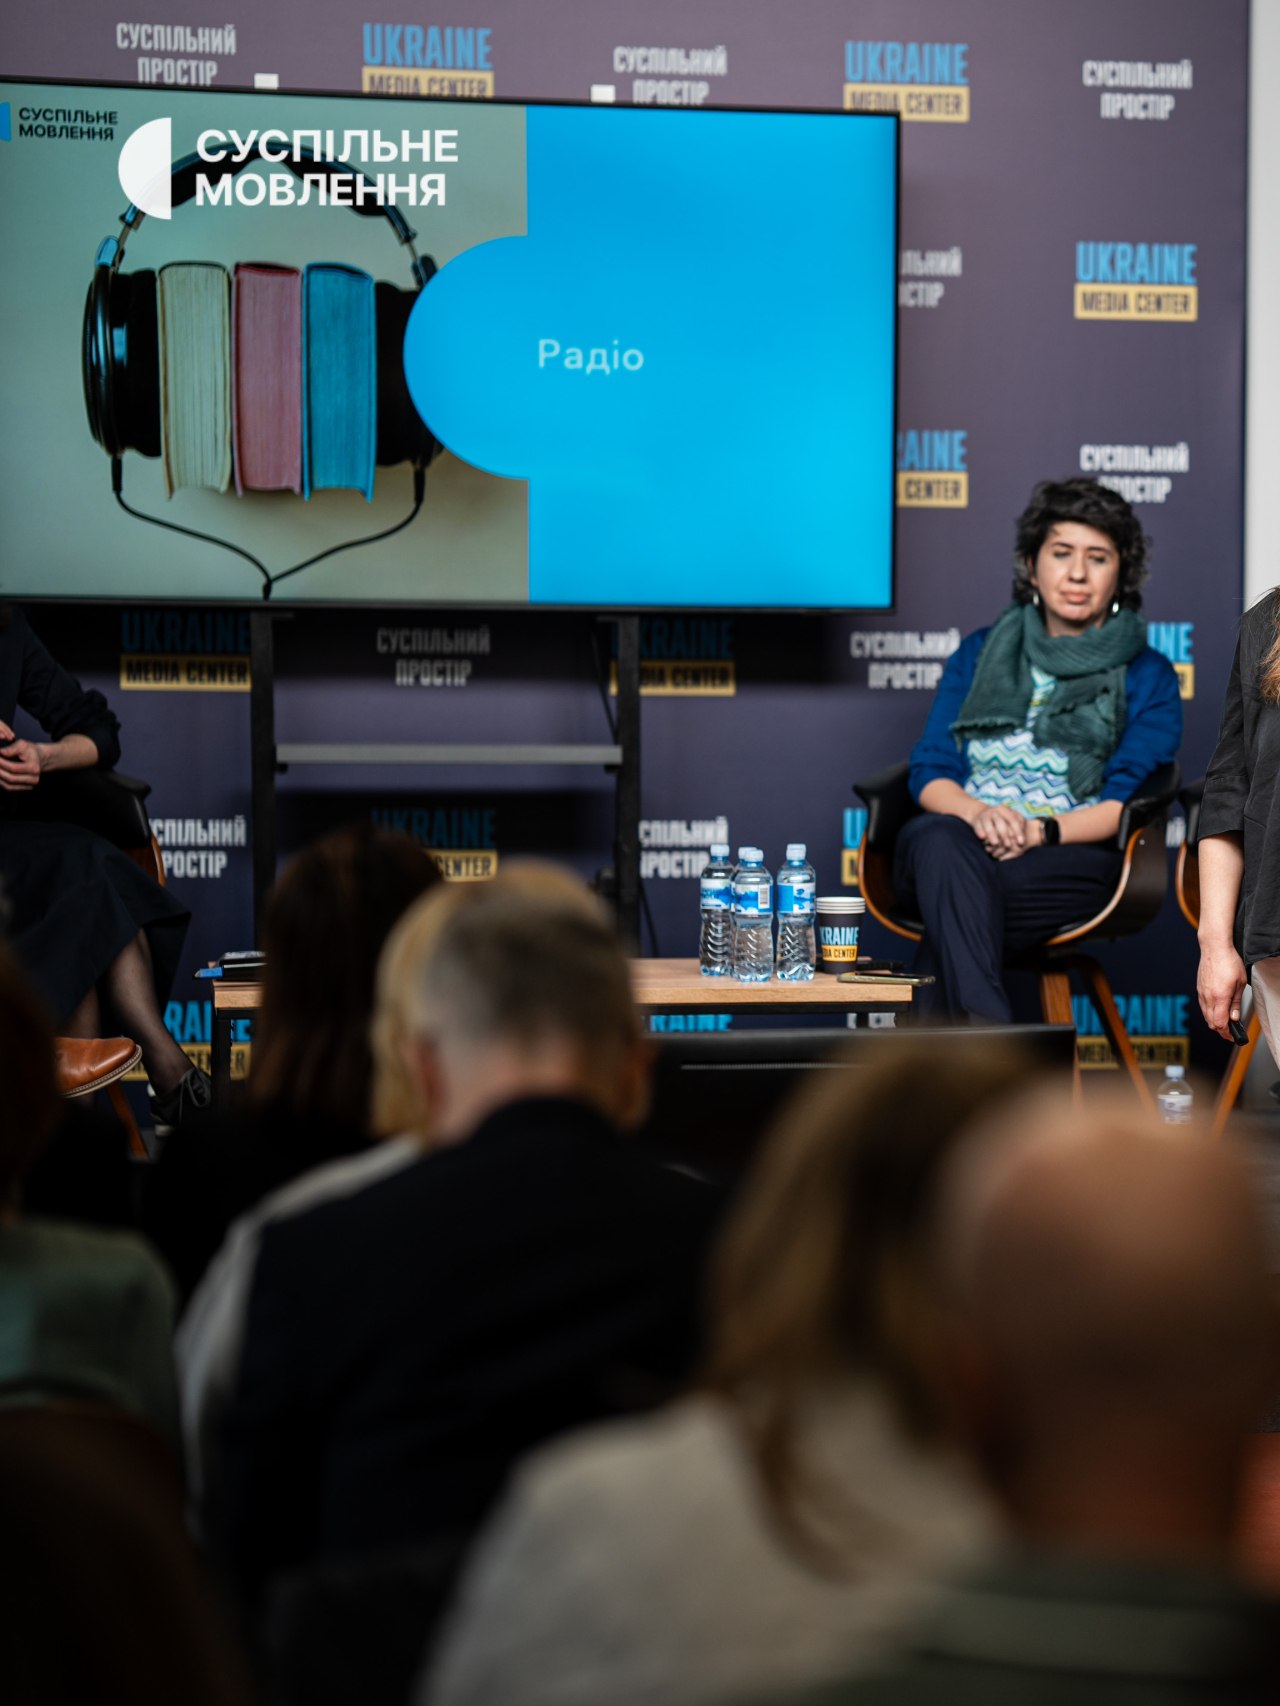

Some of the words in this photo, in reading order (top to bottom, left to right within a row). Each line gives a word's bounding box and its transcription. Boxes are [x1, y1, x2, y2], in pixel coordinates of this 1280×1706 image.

[116, 22, 237, 55] СУСПІЛЬНИЙ
[363, 22, 492, 70] UKRAINE
[137, 57, 218, 86] ПРОСТІР
[613, 45, 727, 76] СУСПІЛЬНИЙ
[845, 40, 968, 85] UKRAINE
[428, 75, 488, 98] CENTER
[19, 107, 118, 125] СУСПІЛЬНЕ
[906, 92, 962, 115] CENTER
[19, 124, 114, 141] МОВЛЕННЯ
[1076, 240, 1197, 285] UKRAINE
[538, 339, 644, 375] Радіо
[898, 430, 967, 471] AINE
[376, 626, 490, 655] СУСПІЛЬНИЙ
[126, 660, 179, 684] MEDIA
[187, 661, 250, 686] CENTER
[395, 659, 472, 686] ПРОСТІР
[161, 850, 228, 878] РОСТІР
